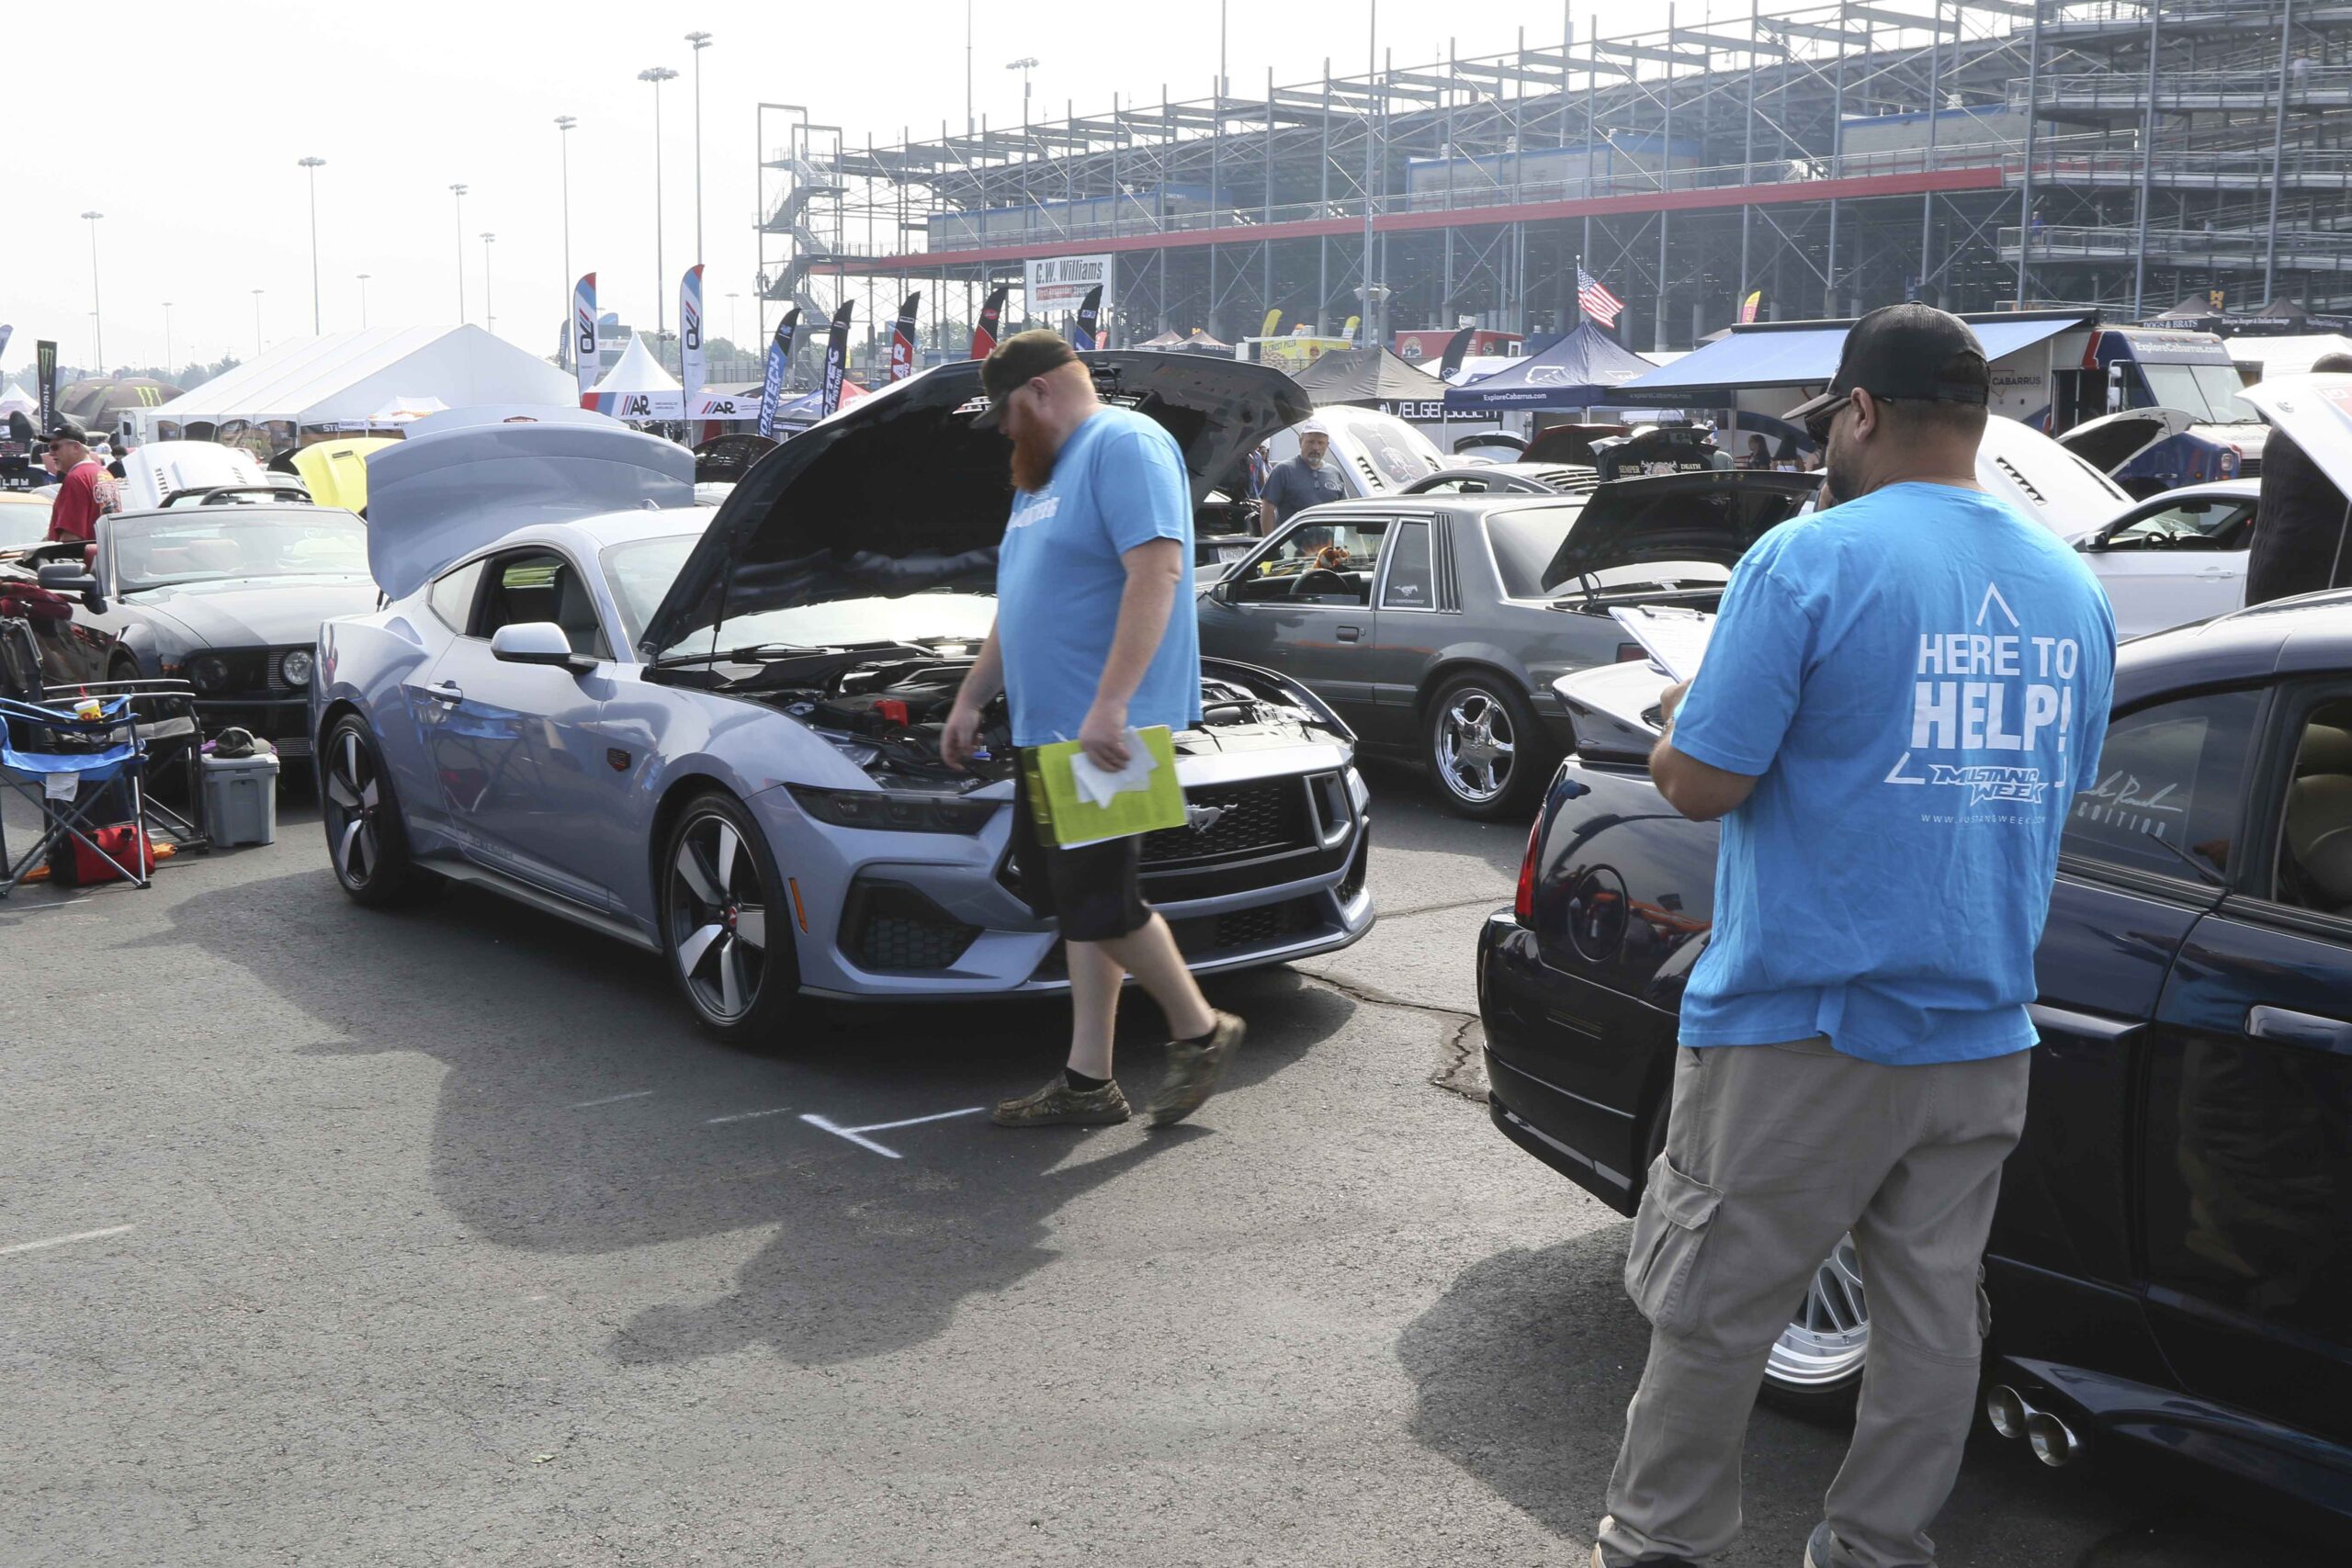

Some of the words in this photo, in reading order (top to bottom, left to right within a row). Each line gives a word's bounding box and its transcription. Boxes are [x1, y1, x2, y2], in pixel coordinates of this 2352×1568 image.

[1036, 262, 1056, 284] C.W.
[1060, 259, 1103, 282] Williams
[2173, 319, 2198, 328] BRATS
[2134, 342, 2223, 353] ExploreCabarrus.com
[1992, 377, 2041, 386] CABARRUS
[1483, 393, 1546, 402] ExploreCabarrus.com
[1618, 465, 1640, 474] SEMPER
[1917, 633, 2020, 676] HERE
[2031, 637, 2078, 680] TO
[1911, 682, 2072, 752] HELP!
[1970, 783, 2049, 807] WEEK
[2077, 801, 2166, 838] EDITION
